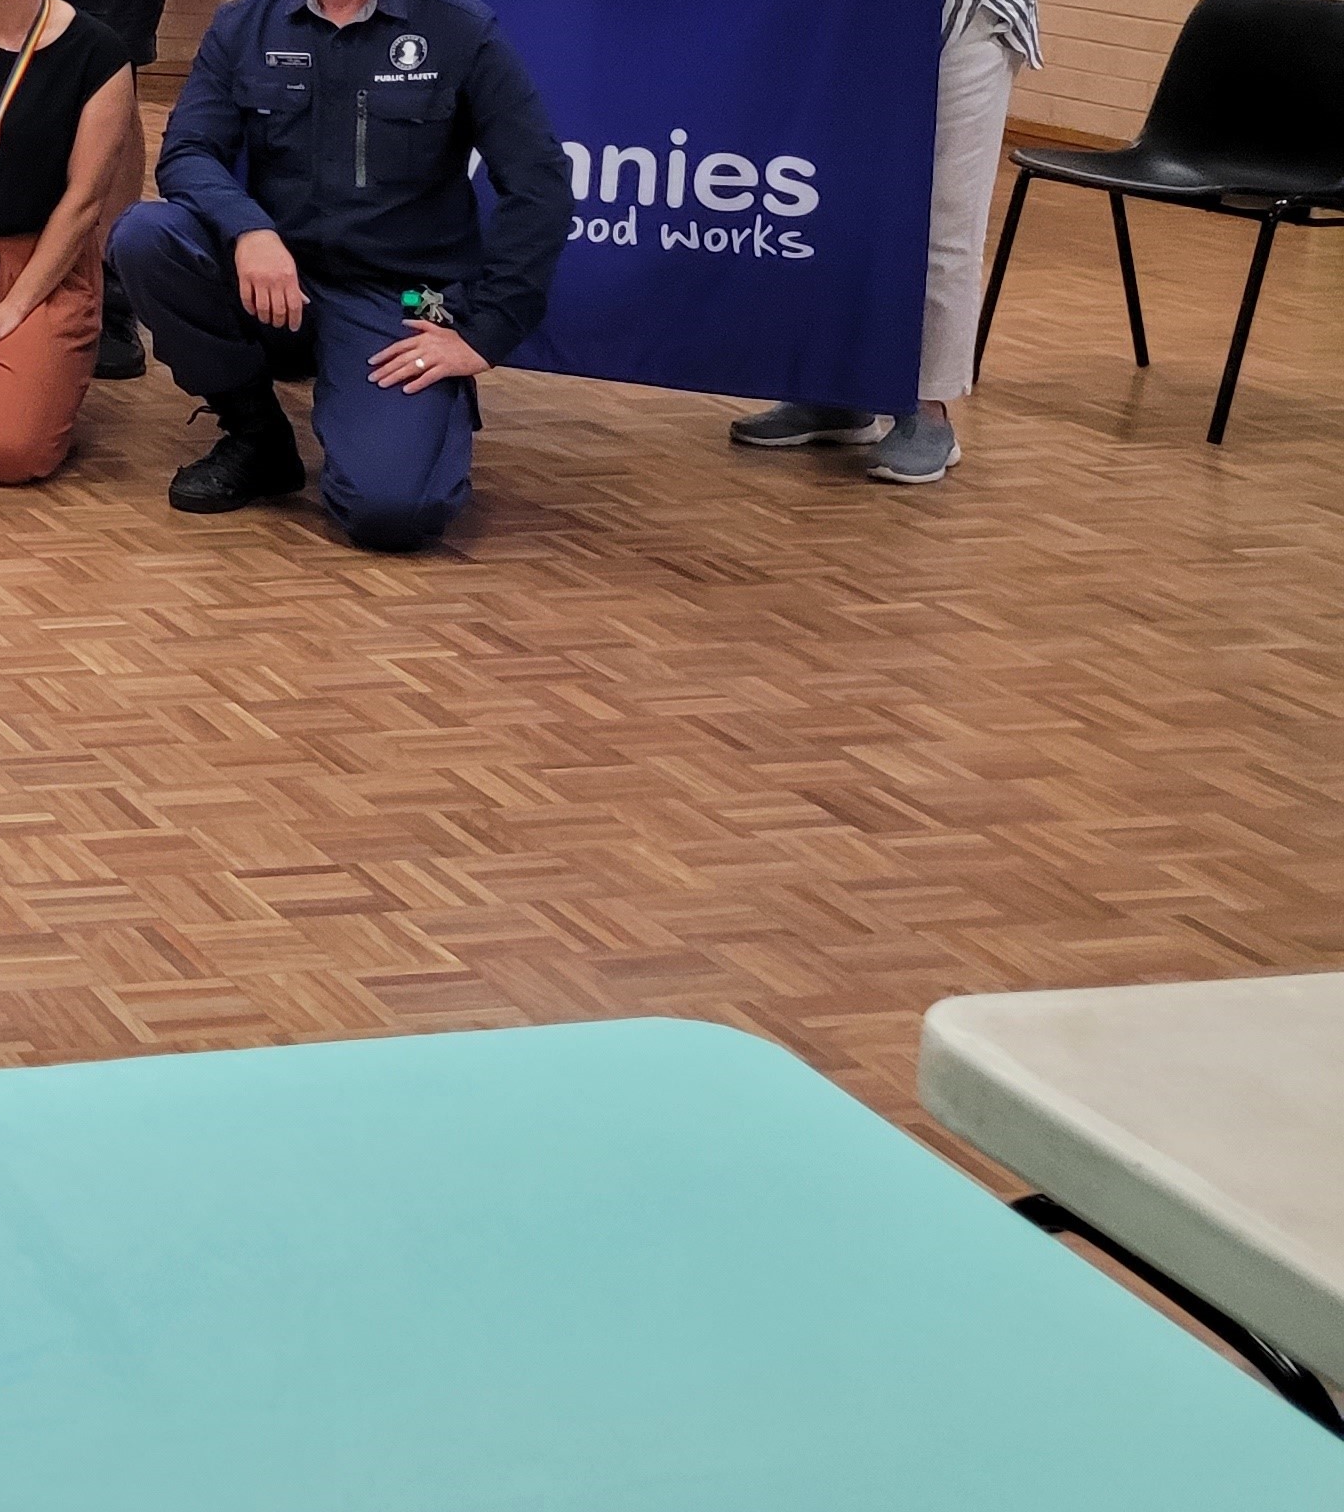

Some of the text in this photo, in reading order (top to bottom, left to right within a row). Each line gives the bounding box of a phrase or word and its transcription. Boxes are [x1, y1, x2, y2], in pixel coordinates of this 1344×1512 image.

[374, 72, 439, 82] PUBLIC SAFETY
[562, 128, 819, 217] nnies
[661, 214, 815, 258] works
